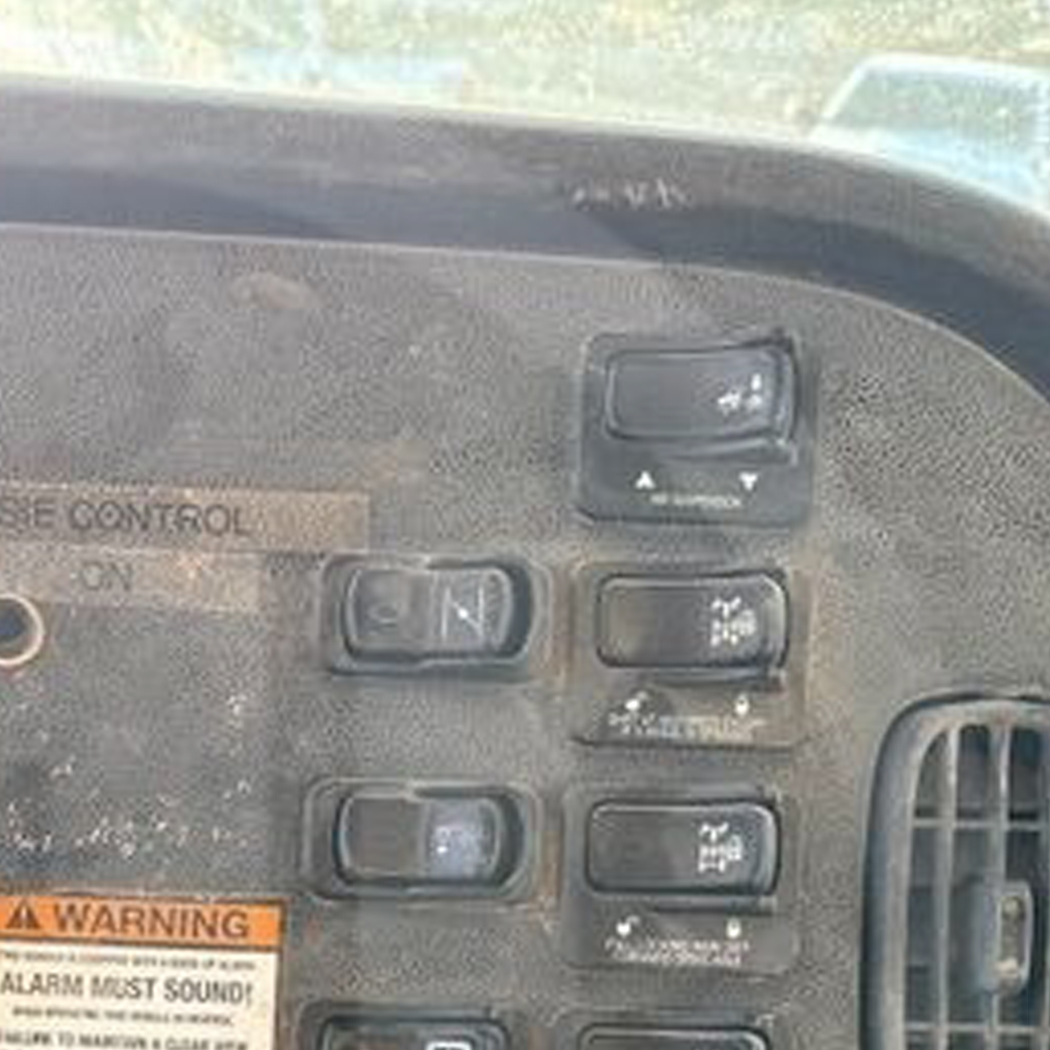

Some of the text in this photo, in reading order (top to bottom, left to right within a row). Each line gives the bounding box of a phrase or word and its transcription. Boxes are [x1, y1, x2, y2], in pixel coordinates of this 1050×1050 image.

[69, 499, 251, 536] CONTROL
[80, 560, 134, 591] ON
[53, 903, 249, 939] WARNING
[0, 971, 253, 1007] ALARM MUST SOUND!
